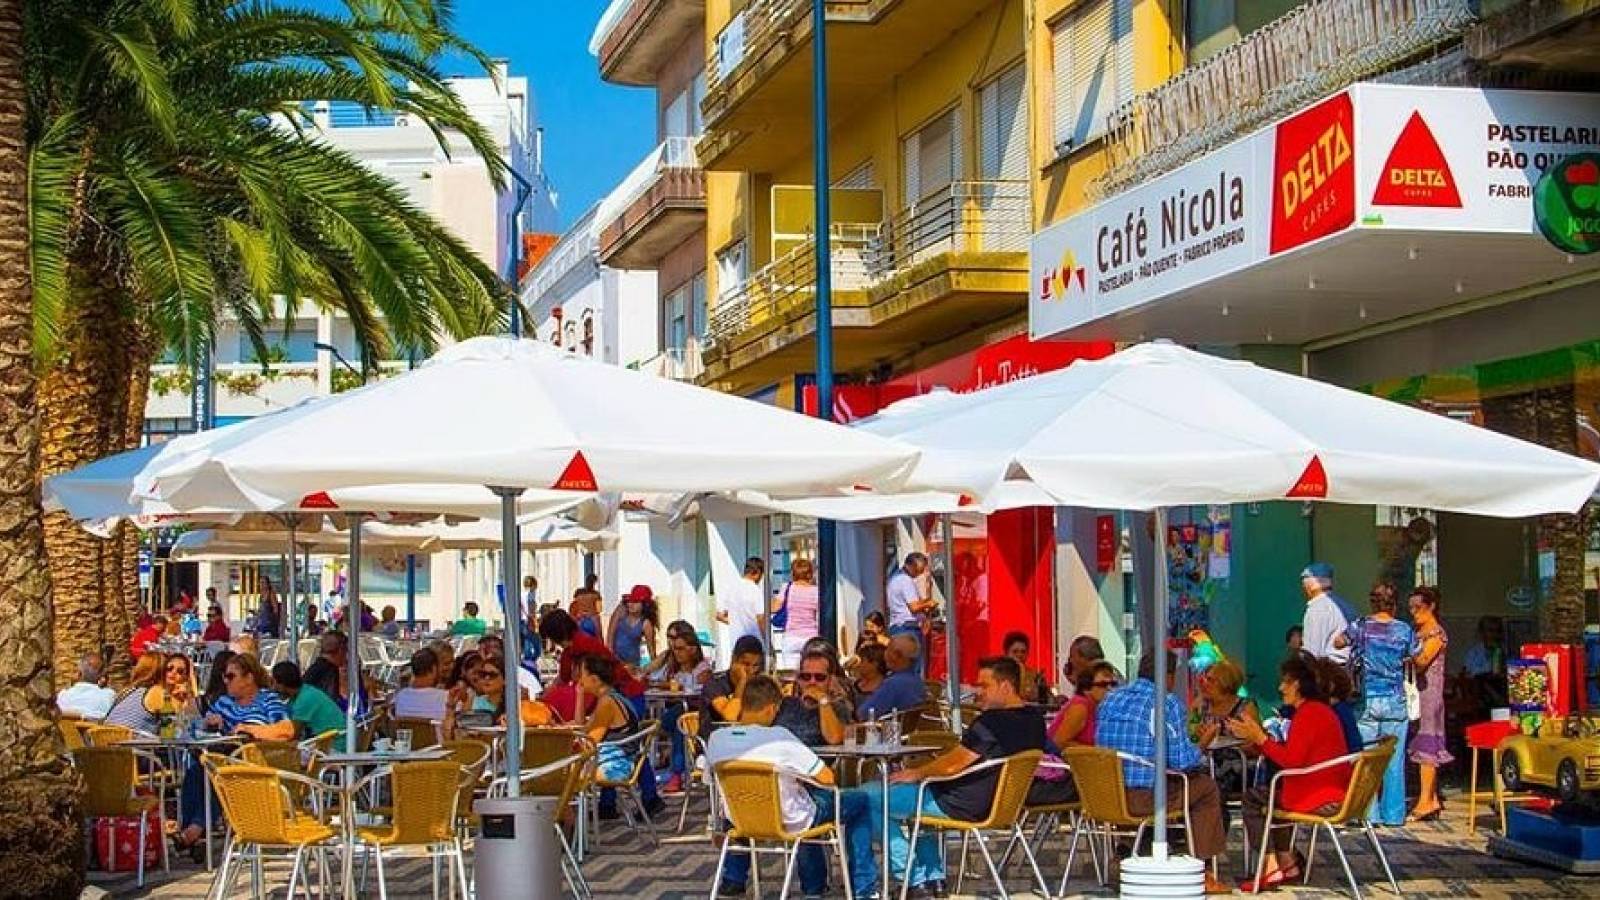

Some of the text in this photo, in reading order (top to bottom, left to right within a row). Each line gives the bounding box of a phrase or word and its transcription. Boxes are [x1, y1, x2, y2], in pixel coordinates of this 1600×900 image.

[1487, 148, 1528, 169] PÃO
[1282, 122, 1351, 219] DELTA
[1391, 168, 1447, 187] DELTA
[1489, 184, 1536, 197] FABRI
[1097, 171, 1244, 273] Café Nicola
